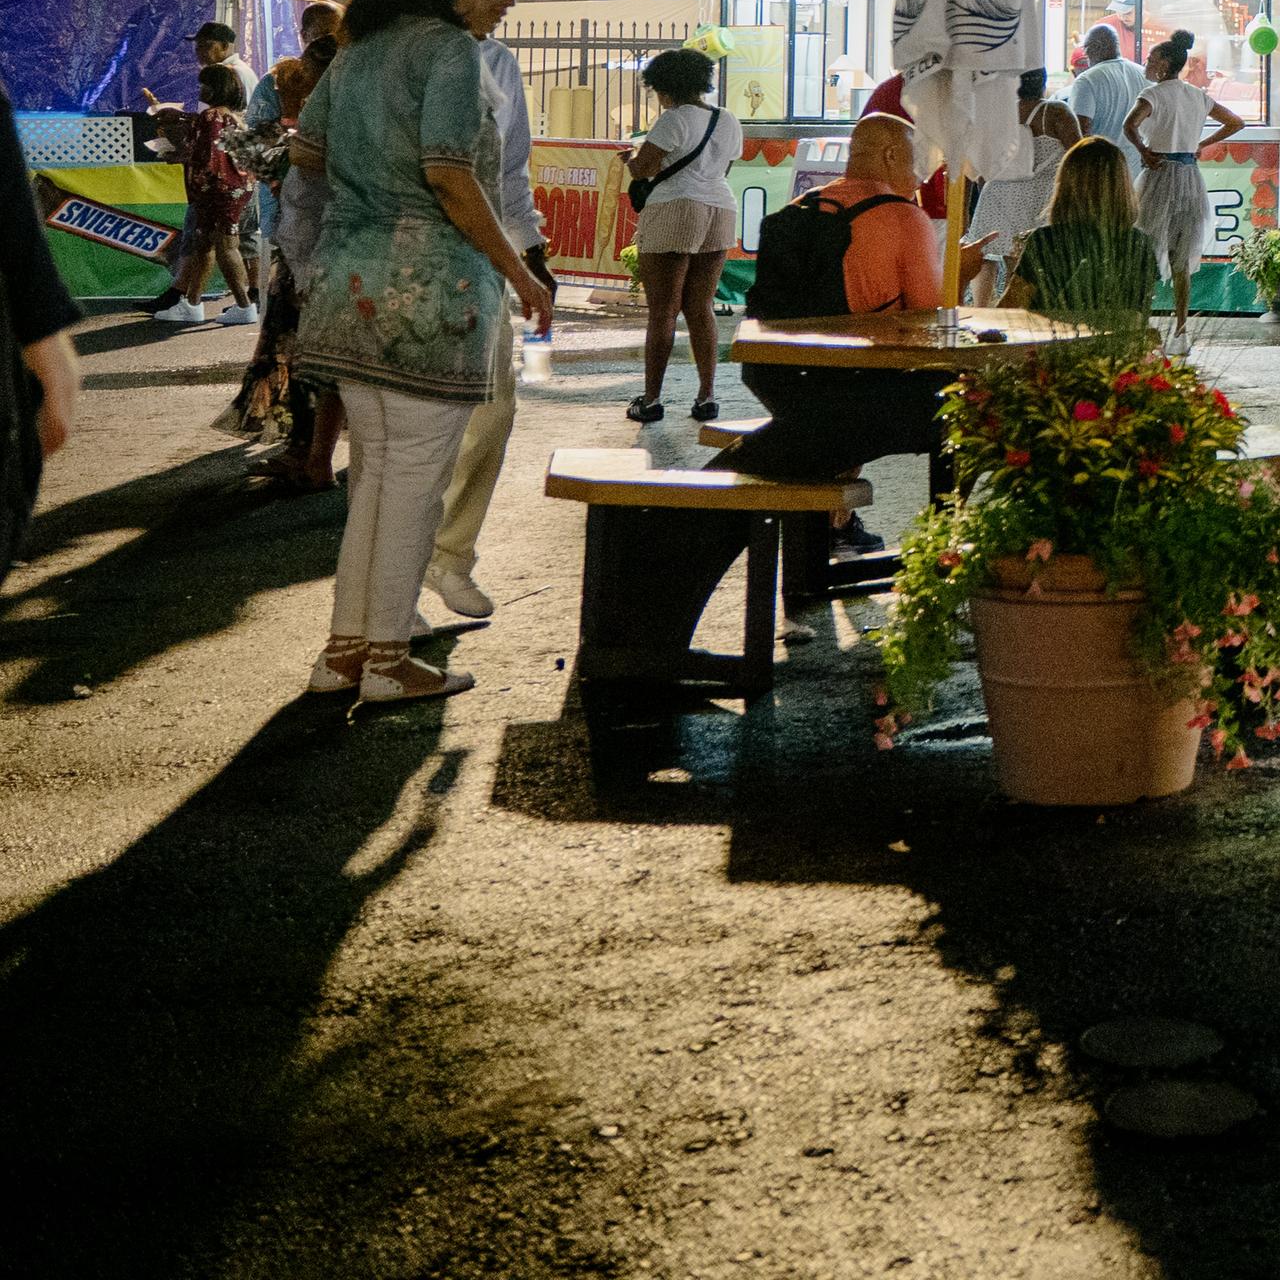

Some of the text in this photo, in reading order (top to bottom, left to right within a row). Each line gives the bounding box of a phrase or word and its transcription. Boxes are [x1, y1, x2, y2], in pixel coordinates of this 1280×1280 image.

[917, 51, 944, 75] CLA
[536, 164, 557, 185] HOT
[566, 166, 598, 188] FRESH
[57, 200, 170, 253] SNICKERS
